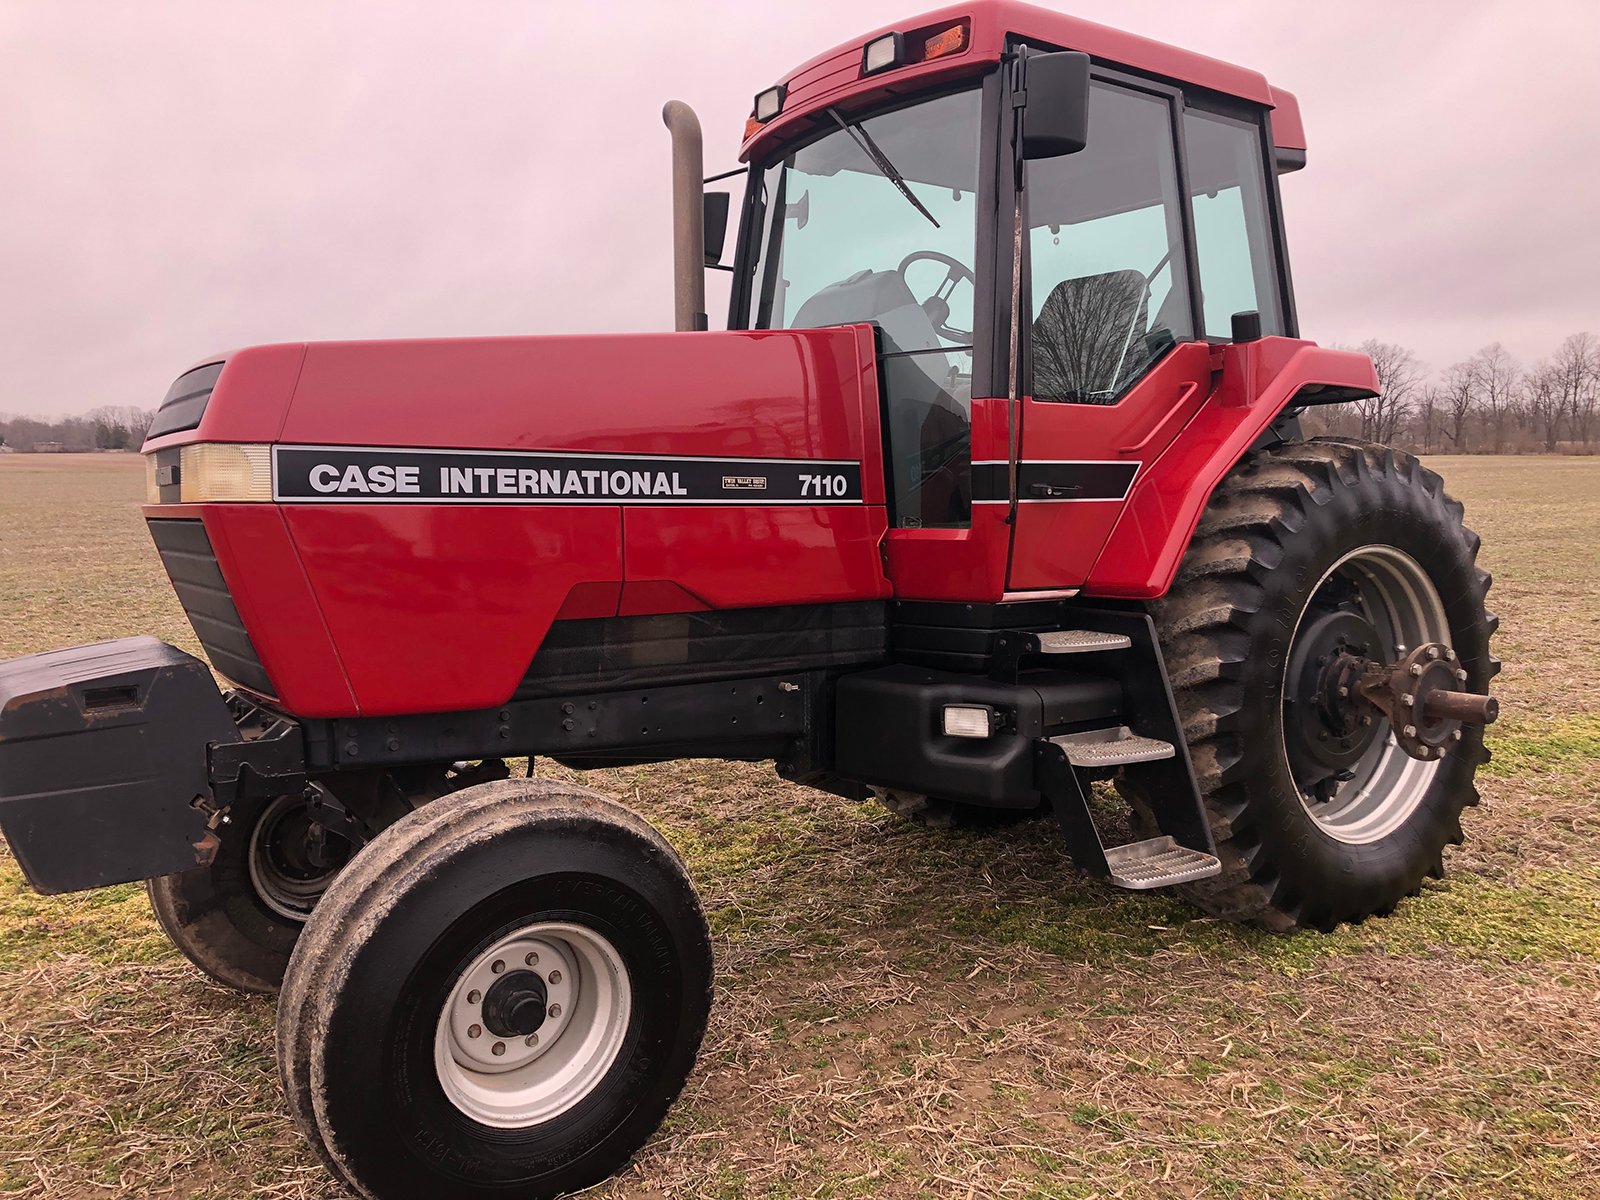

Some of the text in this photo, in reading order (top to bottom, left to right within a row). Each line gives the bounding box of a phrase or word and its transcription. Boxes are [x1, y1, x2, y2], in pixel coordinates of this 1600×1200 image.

[308, 465, 688, 496] CASE INTERNATIONAL
[798, 474, 848, 497] 7110
